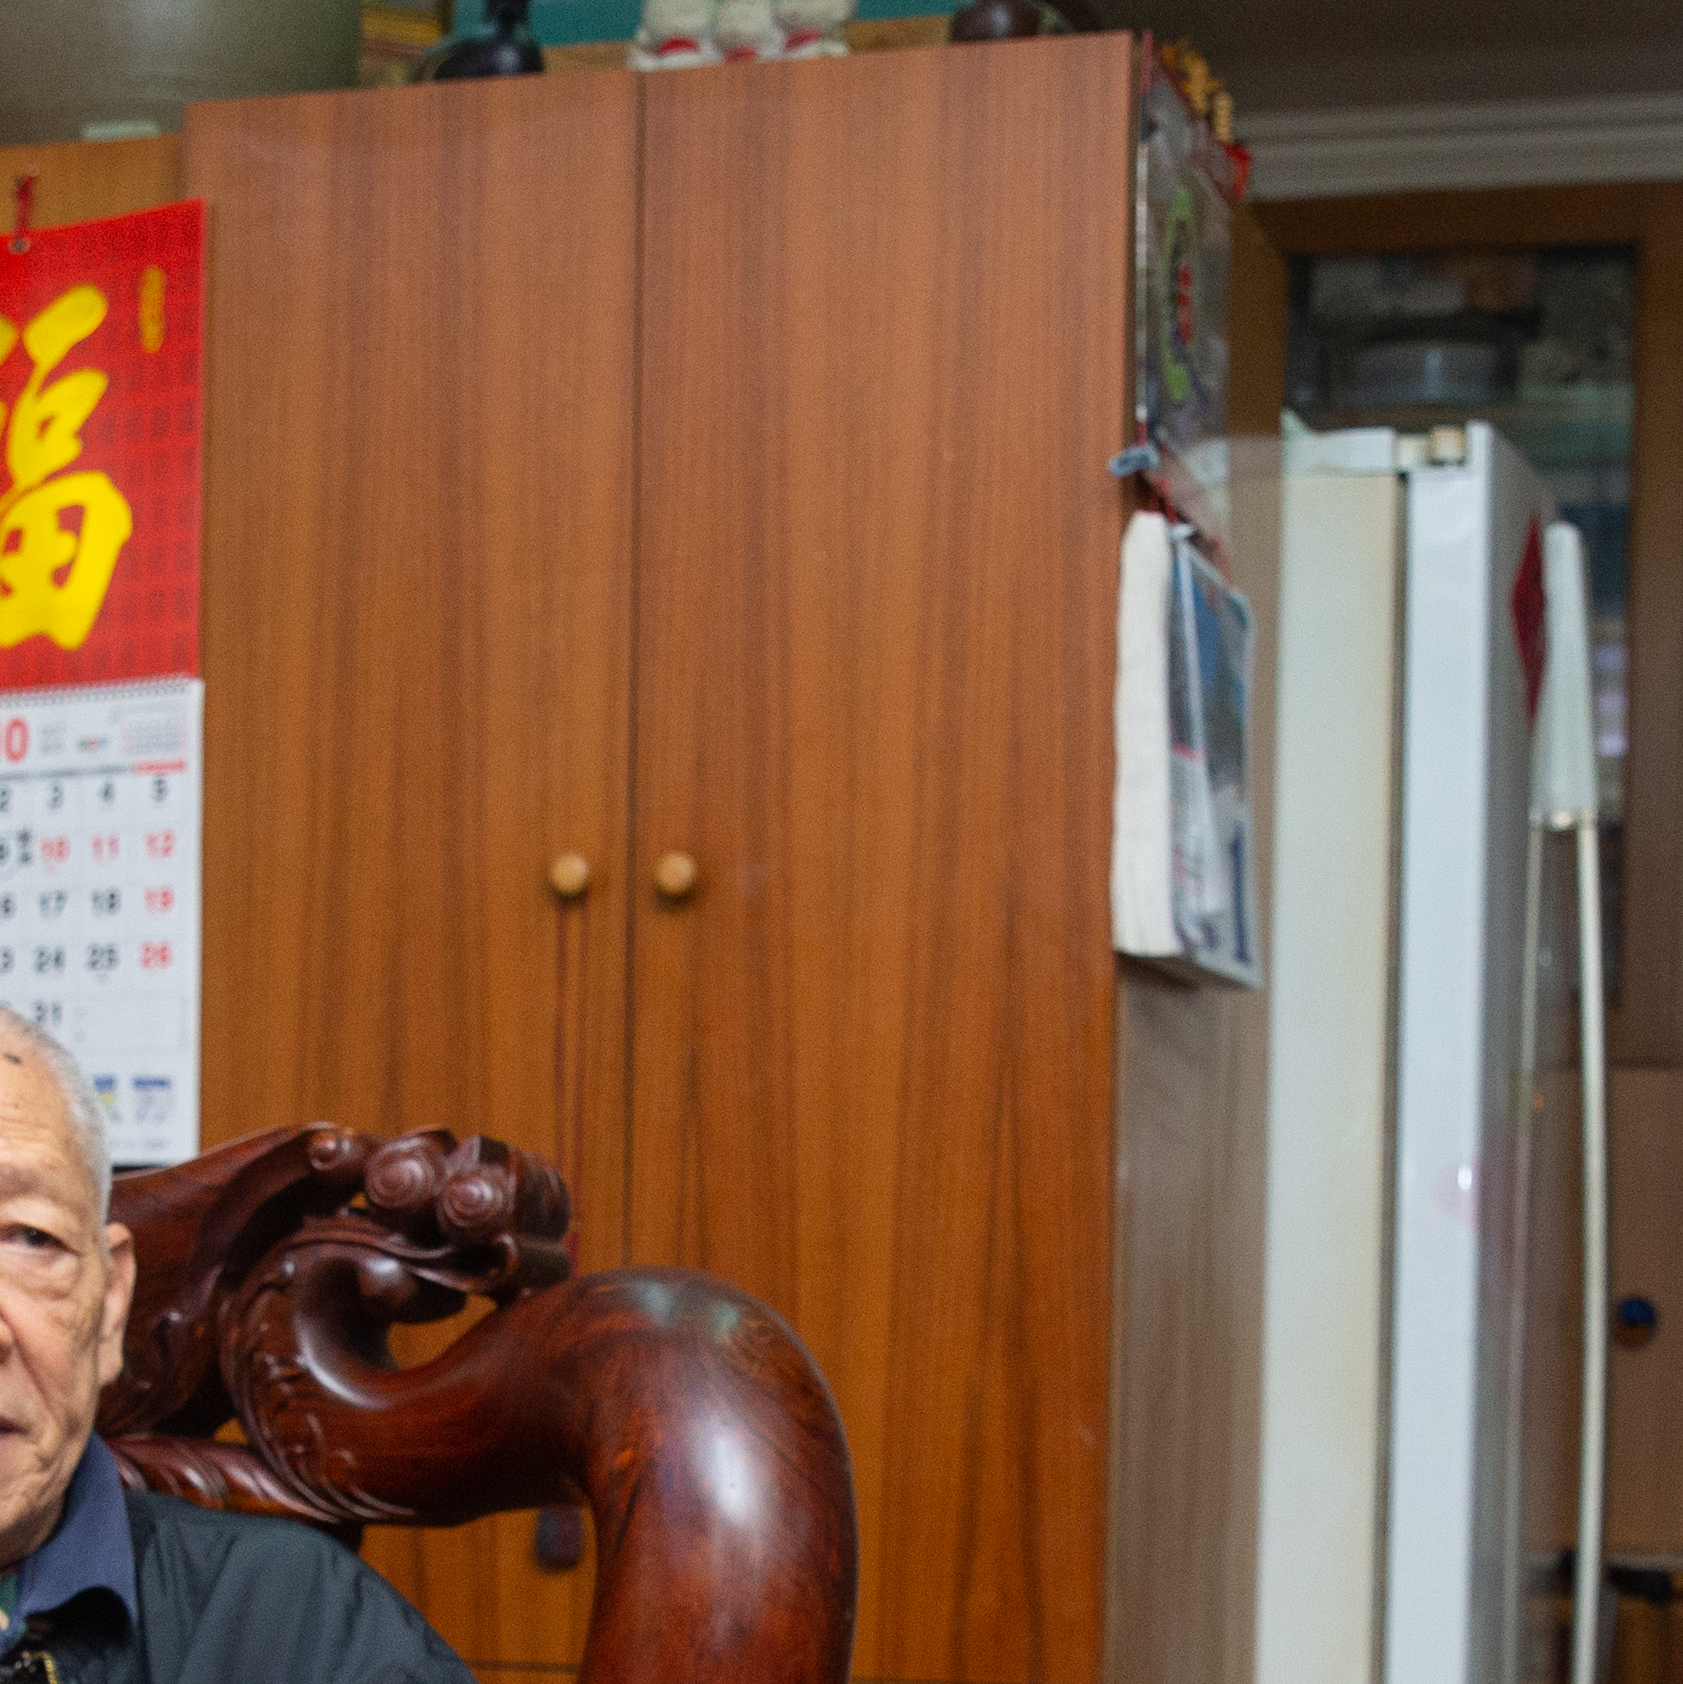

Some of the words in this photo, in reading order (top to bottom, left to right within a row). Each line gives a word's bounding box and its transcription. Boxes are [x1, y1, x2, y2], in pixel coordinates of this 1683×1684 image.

[41, 836, 70, 862] 10
[92, 835, 119, 860] 11
[146, 830, 175, 858] 12
[39, 890, 68, 916] 17
[92, 890, 120, 913] 18
[145, 887, 174, 911] 19
[35, 948, 65, 973] 24
[87, 944, 118, 971] 25
[140, 942, 171, 968] 26
